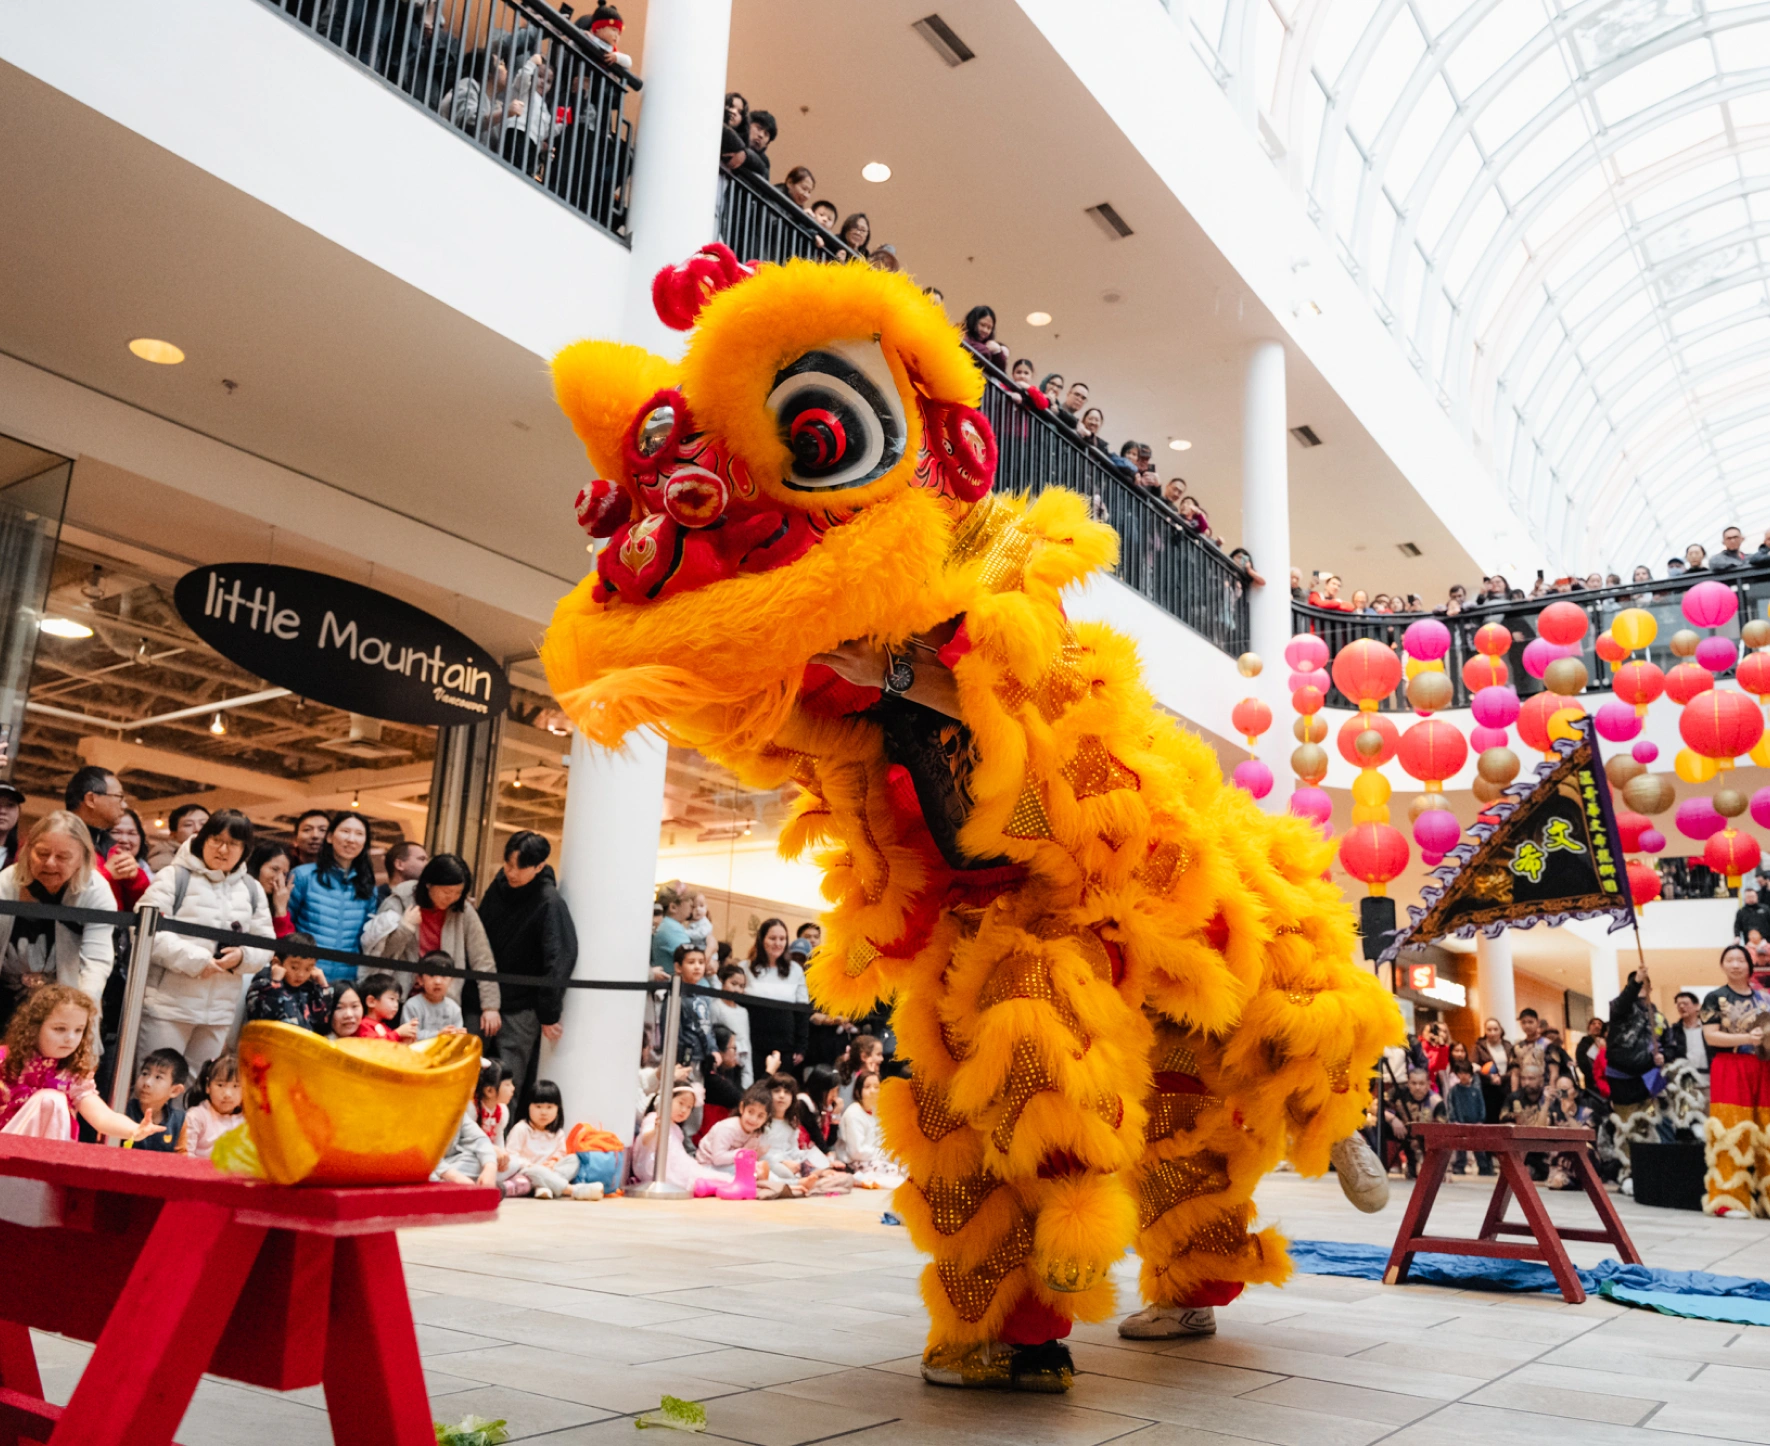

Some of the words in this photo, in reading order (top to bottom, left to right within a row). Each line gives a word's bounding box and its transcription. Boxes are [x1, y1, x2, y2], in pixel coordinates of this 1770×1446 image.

[205, 572, 300, 639] little
[318, 611, 491, 701] Mountain
[433, 687, 488, 715] Vancouver
